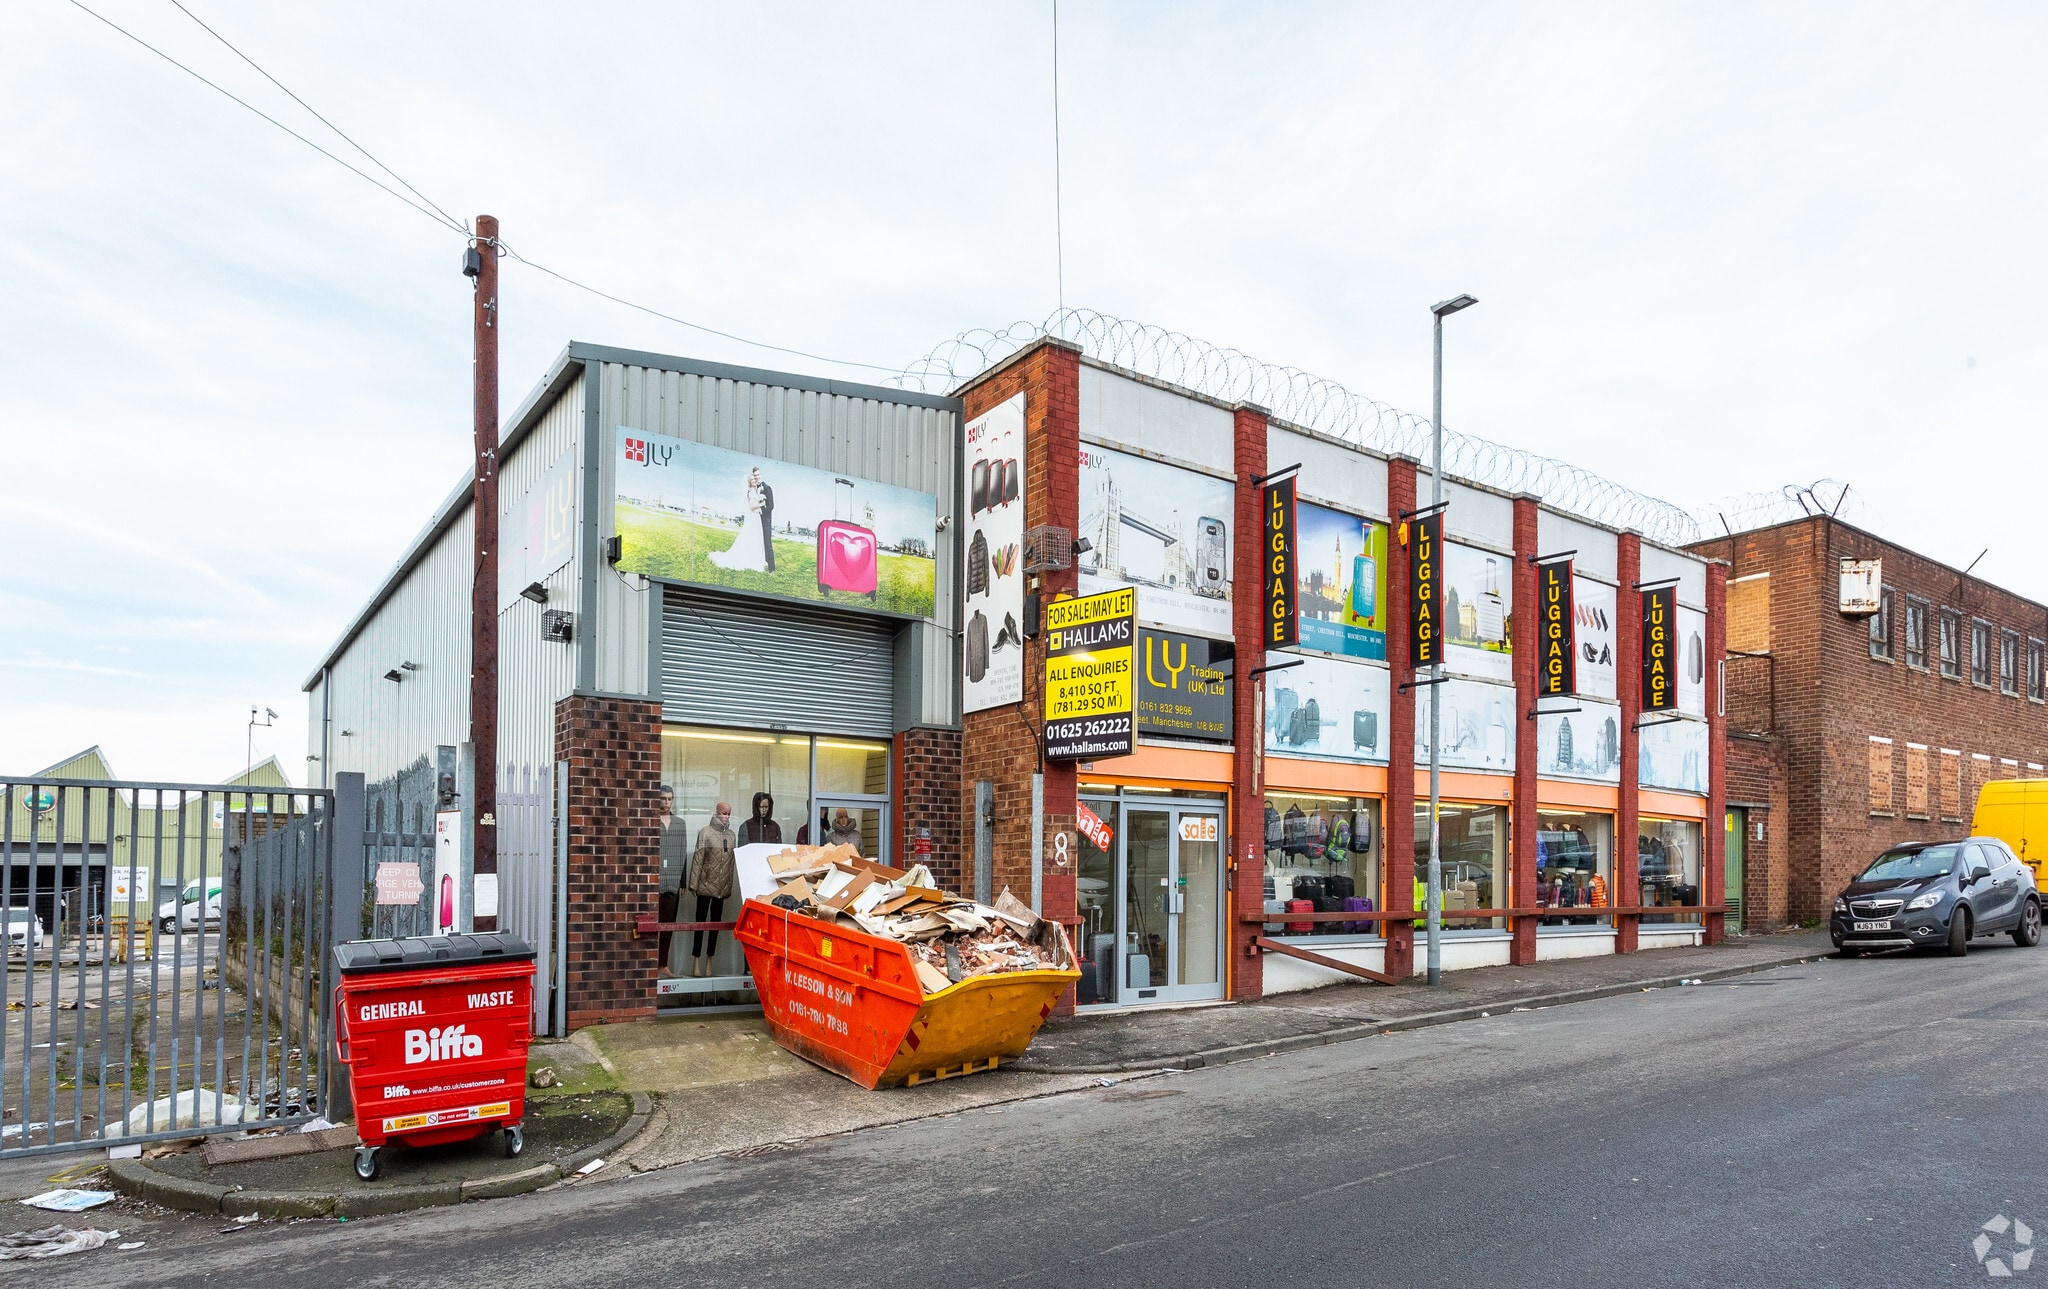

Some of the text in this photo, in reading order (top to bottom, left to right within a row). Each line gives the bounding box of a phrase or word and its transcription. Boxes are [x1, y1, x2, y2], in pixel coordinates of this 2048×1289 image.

[1272, 490, 1285, 642] LUGGAGE
[1418, 524, 1431, 661] LUGGAGE
[1048, 594, 1131, 626] FOR SALE/MAY LET
[1063, 620, 1129, 648] HALLAMS
[1548, 569, 1562, 693] LUGGAGE
[1651, 594, 1665, 706] LUGGAGE
[1049, 660, 1128, 682] ALL ENQUIRIES
[1146, 636, 1186, 689] LY
[1190, 664, 1224, 682] Trading
[1060, 680, 1116, 699] 8,410 SQ FT
[1188, 680, 1224, 696] (UK) Ltd
[1054, 699, 1088, 715] (781.29
[1092, 697, 1104, 710] SQ
[1140, 701, 1192, 716] 0161 832 9896
[1046, 717, 1130, 740] 01625 262222
[1152, 716, 1192, 728] Manchester
[1208, 722, 1224, 733] 8WE
[1048, 740, 1128, 756] www.hallams.com
[1054, 832, 1068, 866] 8
[377, 880, 398, 888] RGE
[360, 991, 514, 1021] GENERAL WASTE
[835, 987, 852, 1006] SON
[405, 1024, 482, 1064] Biffa
[384, 1085, 410, 1098] Biffa
[412, 1078, 505, 1094] www.biffa.co.uk/customerzone
